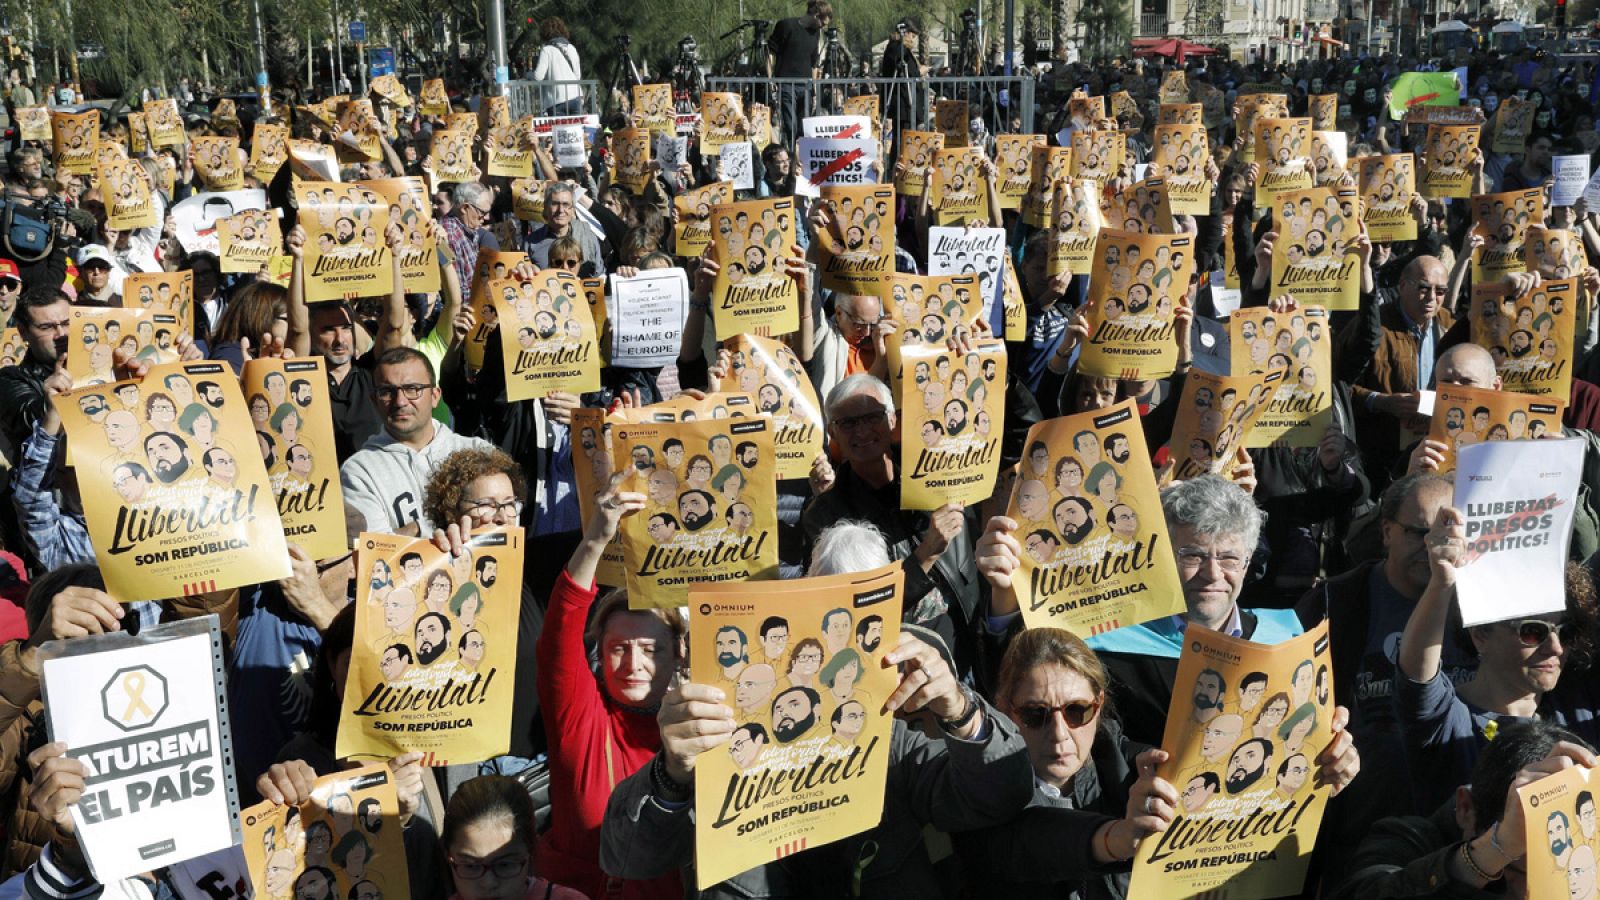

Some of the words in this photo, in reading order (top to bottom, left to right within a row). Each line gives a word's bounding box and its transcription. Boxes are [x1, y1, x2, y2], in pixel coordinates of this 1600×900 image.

[492, 151, 528, 163] Llibertat!
[112, 200, 148, 216] Llibertat!
[934, 194, 983, 212] Llibertat!
[1364, 206, 1409, 222] Llibertat!
[226, 244, 278, 257] Llibertat!
[933, 234, 1000, 256] Llibertat!
[312, 247, 384, 276] Llibertat!
[826, 255, 889, 272] Llibertat!
[1278, 261, 1354, 287] Llibertat!
[721, 277, 793, 309] Llibertat!
[752, 305, 786, 314] REPÚBLICA
[640, 317, 662, 326] THE
[1090, 319, 1177, 344] Llibertat!
[622, 332, 662, 342] SHAME
[665, 331, 680, 339] OF
[512, 341, 591, 375] Llibertat!
[627, 345, 673, 355] EUROPE
[910, 438, 997, 479] Llibertat!
[925, 480, 946, 488] SOM
[948, 474, 984, 486] REPÚBLICA
[1467, 497, 1557, 517] LLIBERTAT
[108, 484, 259, 555] Llibertat!
[1466, 514, 1553, 537] PRESOS
[284, 524, 316, 536] BLICA
[160, 536, 187, 546] PRESOS
[135, 552, 169, 566] SOM
[172, 538, 249, 560] REPÚBLICA
[636, 531, 768, 577] Llibertat!
[174, 568, 221, 580] BARCELONA
[657, 578, 685, 586] SOM
[687, 570, 750, 584] REPÚBLICA
[1030, 534, 1158, 612] Llibertat!
[1048, 602, 1078, 617] SOM
[1082, 582, 1147, 606] REPÚBLICA
[1203, 646, 1241, 662] ÒMNIUM
[353, 668, 496, 716] Llibertat!
[373, 721, 405, 732] SOM
[408, 719, 473, 732] REPÚBLICA
[79, 728, 208, 776] ATUREM
[712, 736, 879, 828] Llibertat!
[1539, 784, 1568, 800] ÒMNIUM
[79, 790, 122, 824] EL
[127, 763, 215, 813] PAÍS
[763, 798, 789, 810] PRESOS
[791, 790, 825, 802] POLÍTICS
[736, 815, 770, 837] SOM
[772, 794, 850, 824] REPÚBLICA
[769, 826, 815, 844] BARCELONA
[1147, 794, 1316, 865] Llibertat!
[1195, 845, 1221, 854] PRESOS
[1164, 860, 1198, 873] SOM
[1200, 851, 1278, 868] REPÚBLICA
